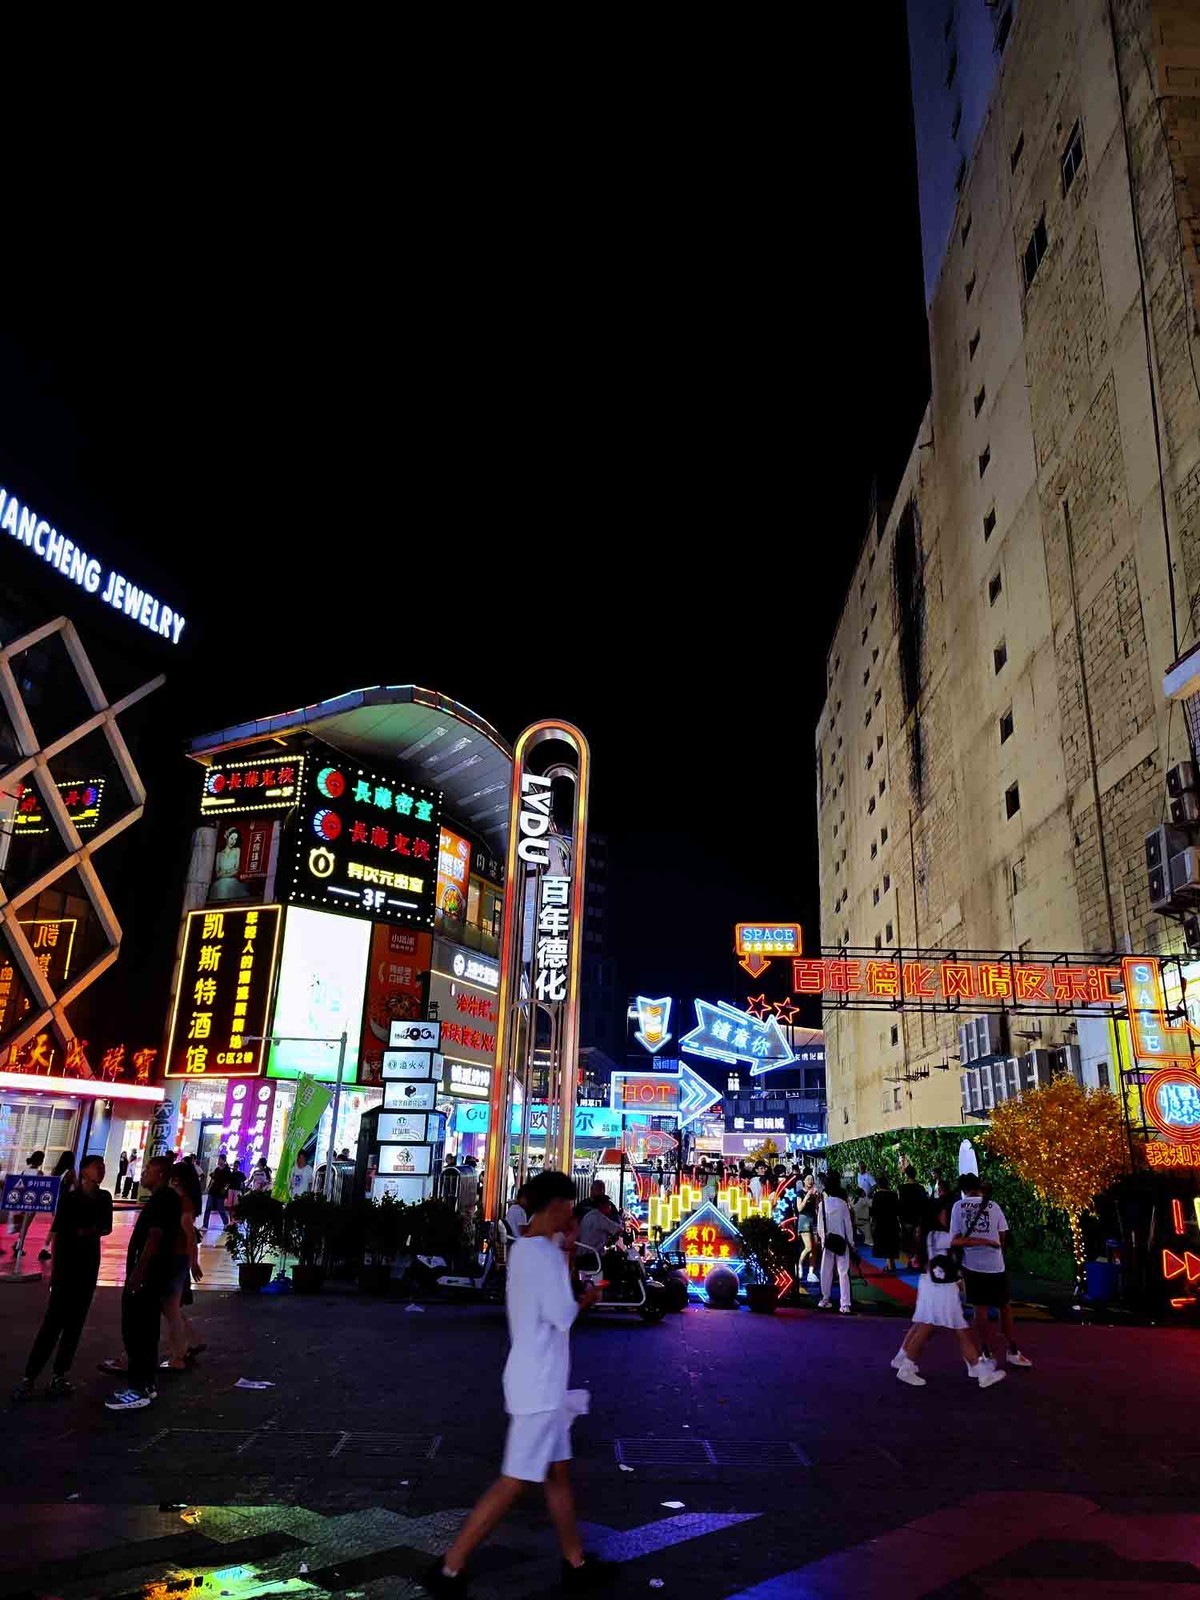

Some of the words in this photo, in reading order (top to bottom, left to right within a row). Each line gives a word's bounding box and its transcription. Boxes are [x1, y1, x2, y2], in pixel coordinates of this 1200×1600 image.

[102, 570, 186, 645] JEWELRY
[518, 772, 552, 866] LVDU
[362, 887, 387, 908] 3F
[534, 875, 571, 1001] 百年德化
[742, 928, 795, 942] SPACE
[185, 912, 225, 1073] 凯斯特酒馆
[791, 957, 1126, 1003] 百年德化风情夜乐汇
[1134, 964, 1162, 1053] SALE
[622, 1084, 671, 1103] HOT
[685, 1226, 716, 1241] 我们
[685, 1244, 730, 1258] 在这里
